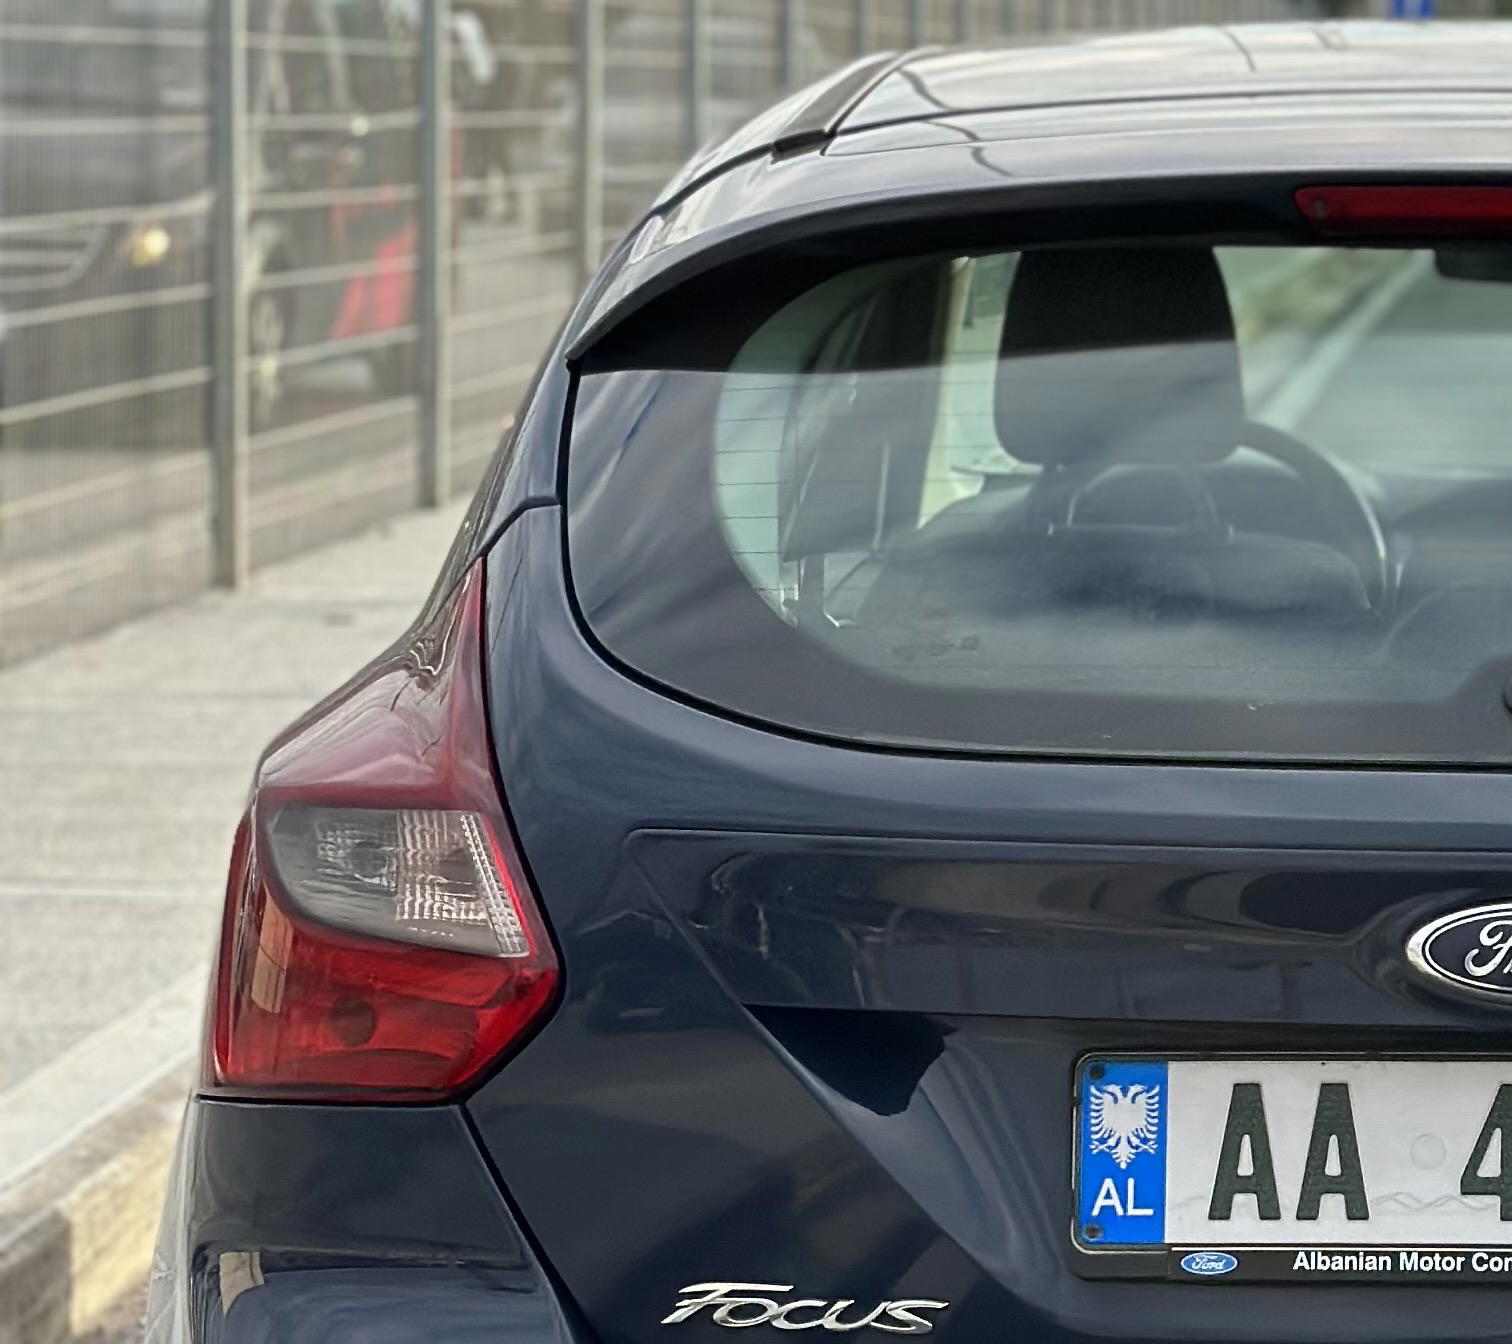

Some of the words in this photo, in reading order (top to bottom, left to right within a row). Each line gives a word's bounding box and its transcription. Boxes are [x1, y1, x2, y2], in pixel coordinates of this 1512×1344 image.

[1208, 1083, 1369, 1220] AA
[1091, 1177, 1154, 1216] AL
[1191, 1255, 1227, 1269] Ford
[1293, 1252, 1391, 1271] Albanian
[1400, 1252, 1465, 1271] Motor
